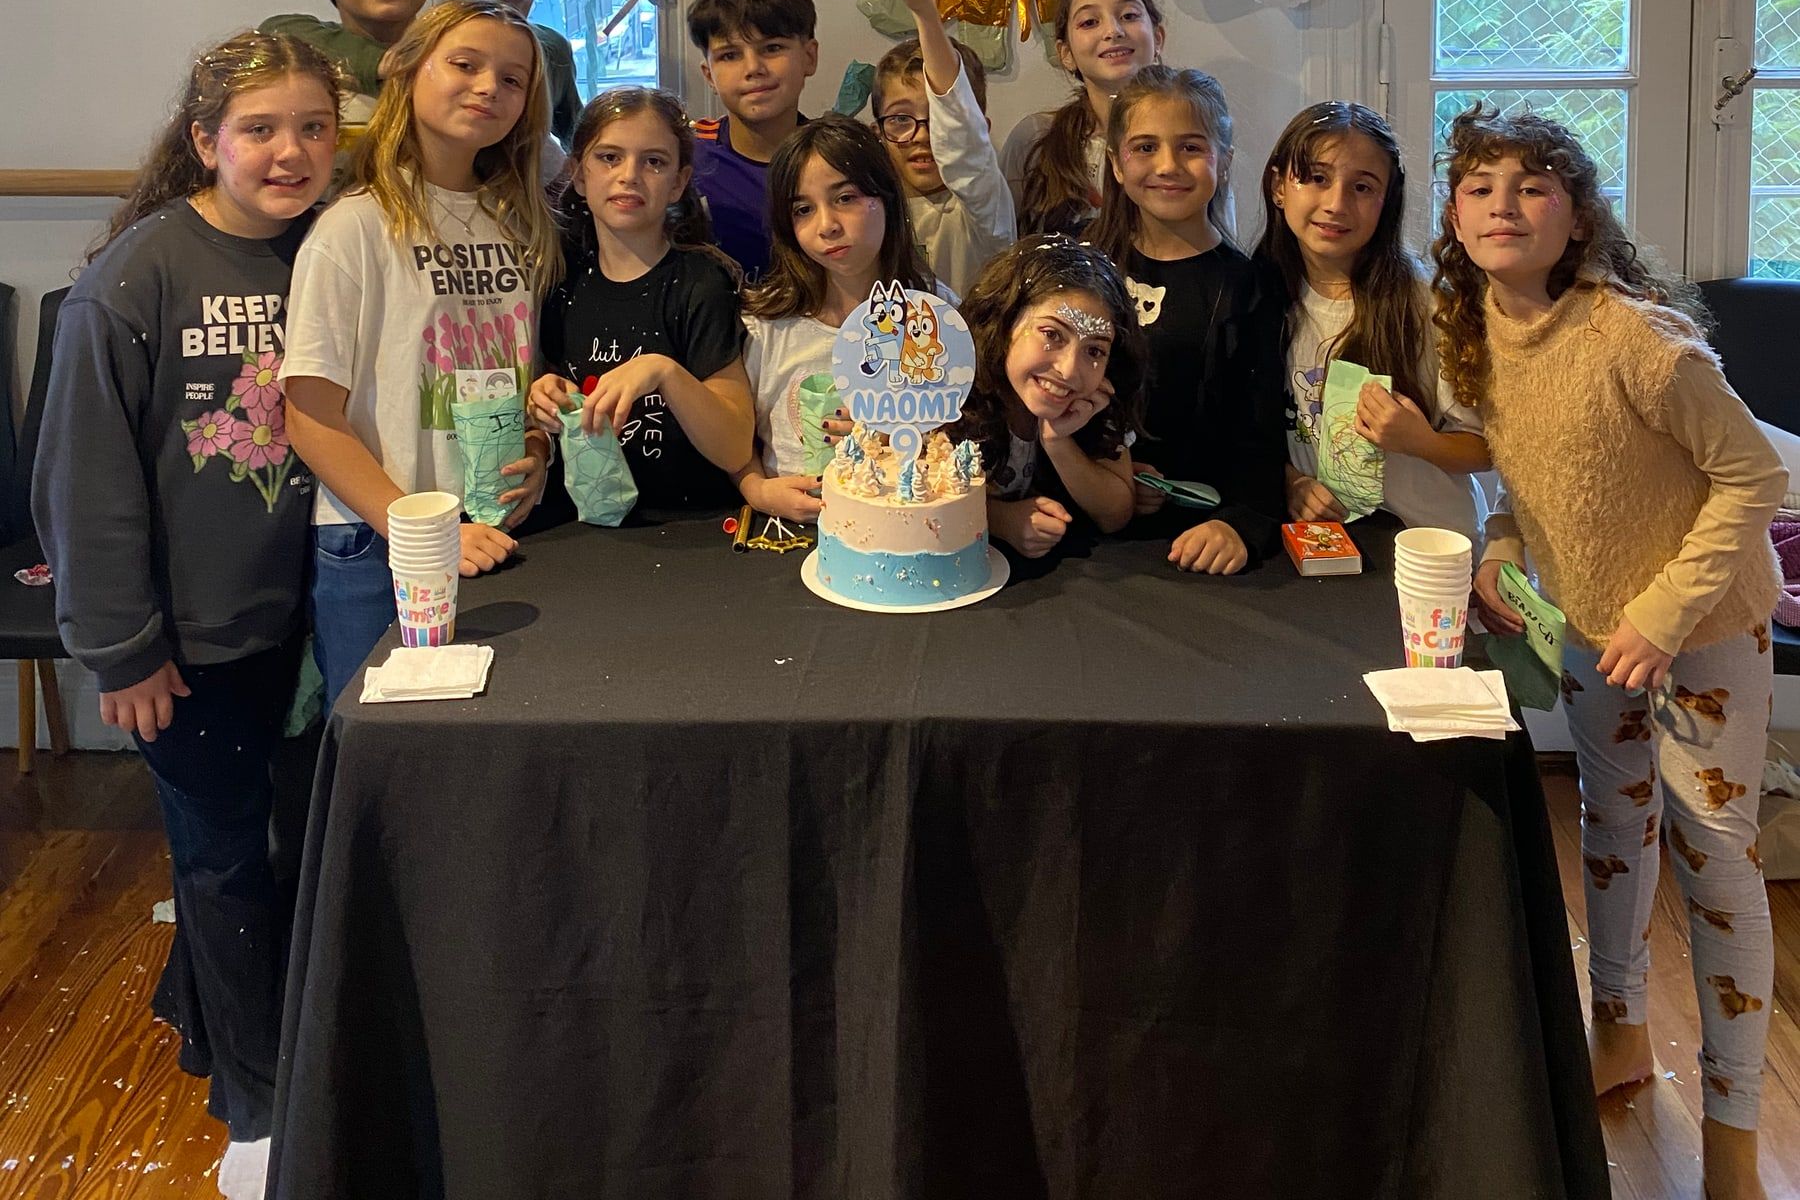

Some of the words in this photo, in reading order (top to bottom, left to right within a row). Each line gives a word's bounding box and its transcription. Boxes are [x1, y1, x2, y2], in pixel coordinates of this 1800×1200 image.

[430, 267, 531, 296] ENERGY
[202, 294, 282, 325] KEEP
[185, 383, 215, 392] INSPIRE
[185, 392, 214, 400] PEOPLE
[853, 391, 961, 421] NAOMI
[893, 428, 919, 468] 9
